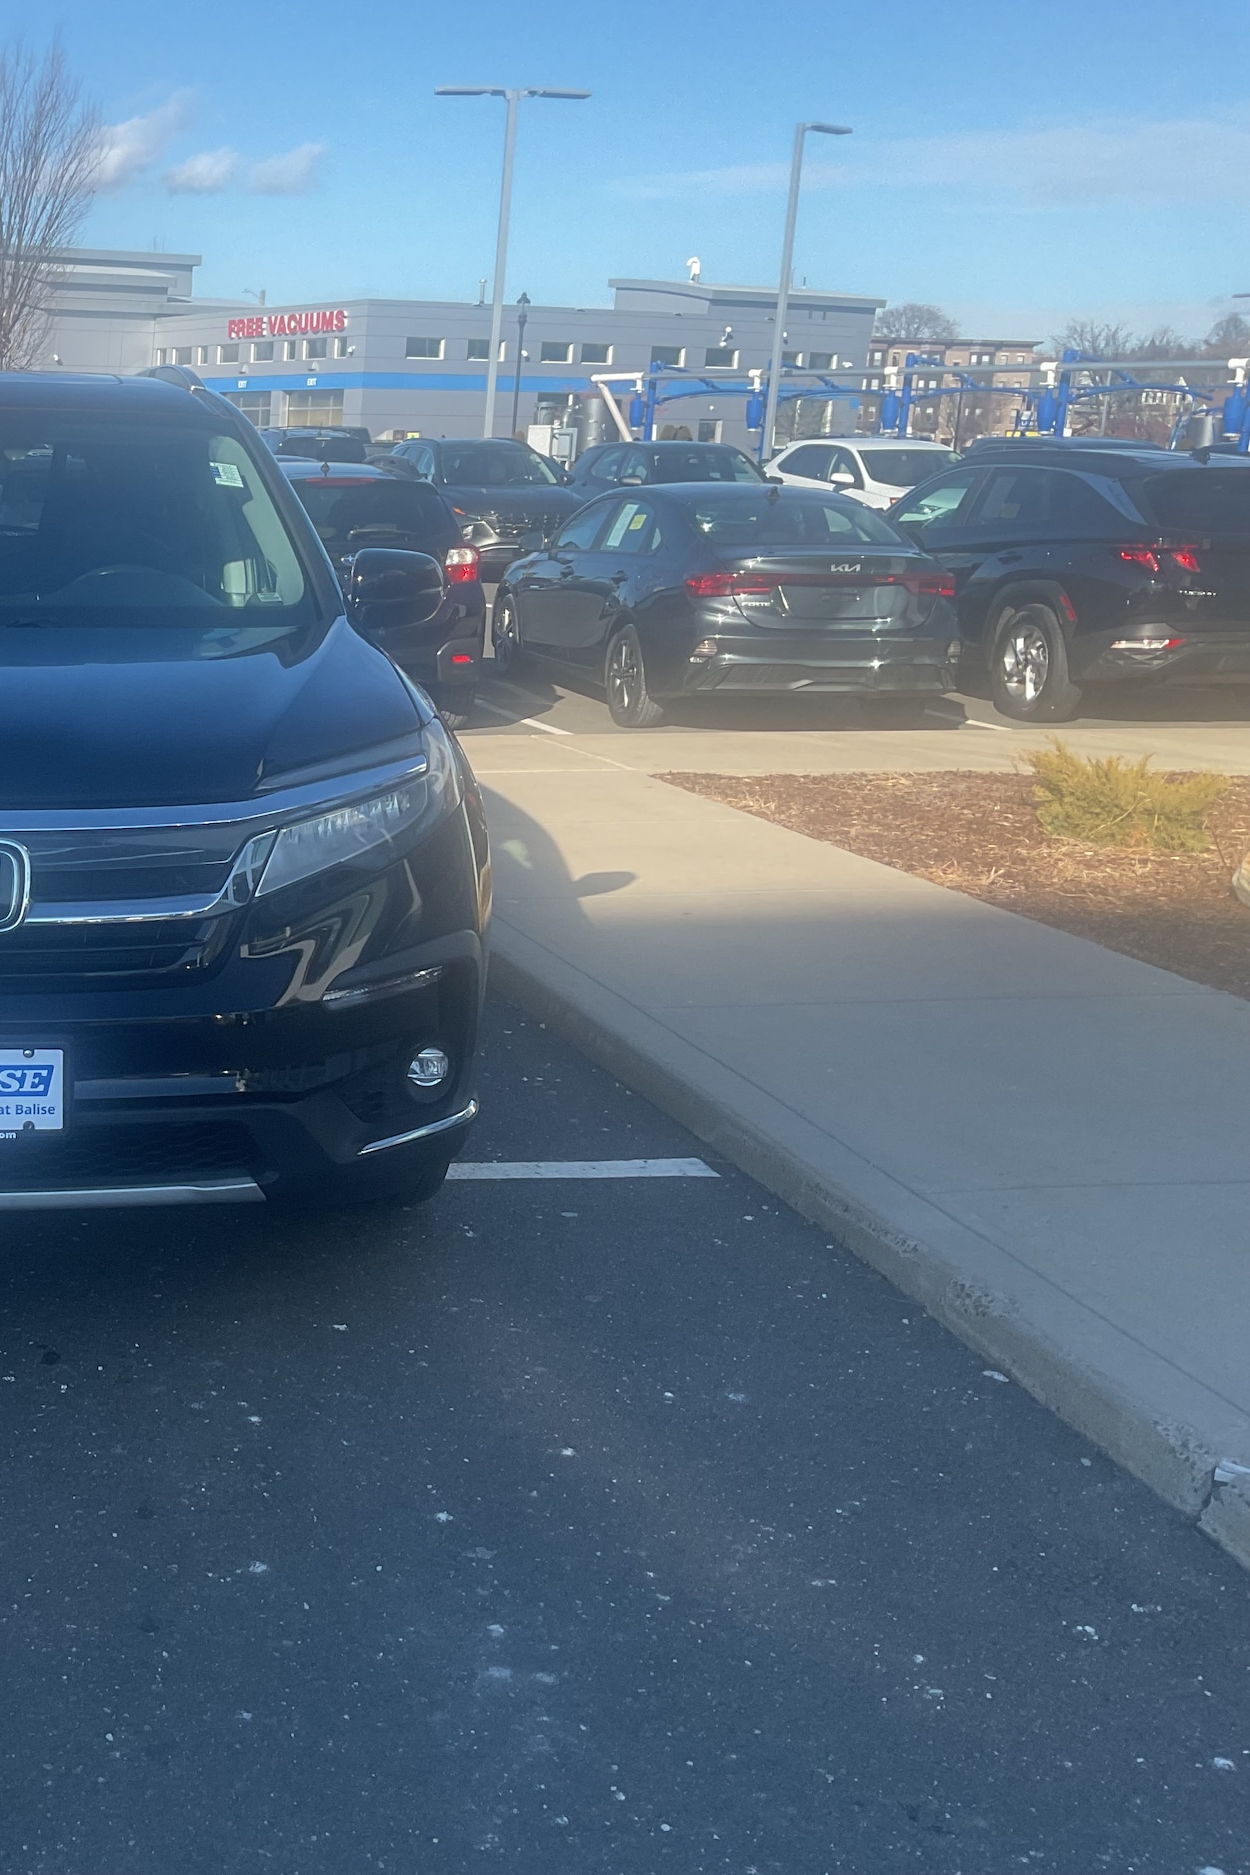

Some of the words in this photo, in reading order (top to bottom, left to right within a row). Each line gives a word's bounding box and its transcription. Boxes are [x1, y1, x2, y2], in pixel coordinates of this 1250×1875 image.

[228, 315, 267, 339] FREE
[268, 309, 348, 336] VACUUMS
[830, 563, 861, 572] KIA
[15, 1104, 56, 1115] Balise
